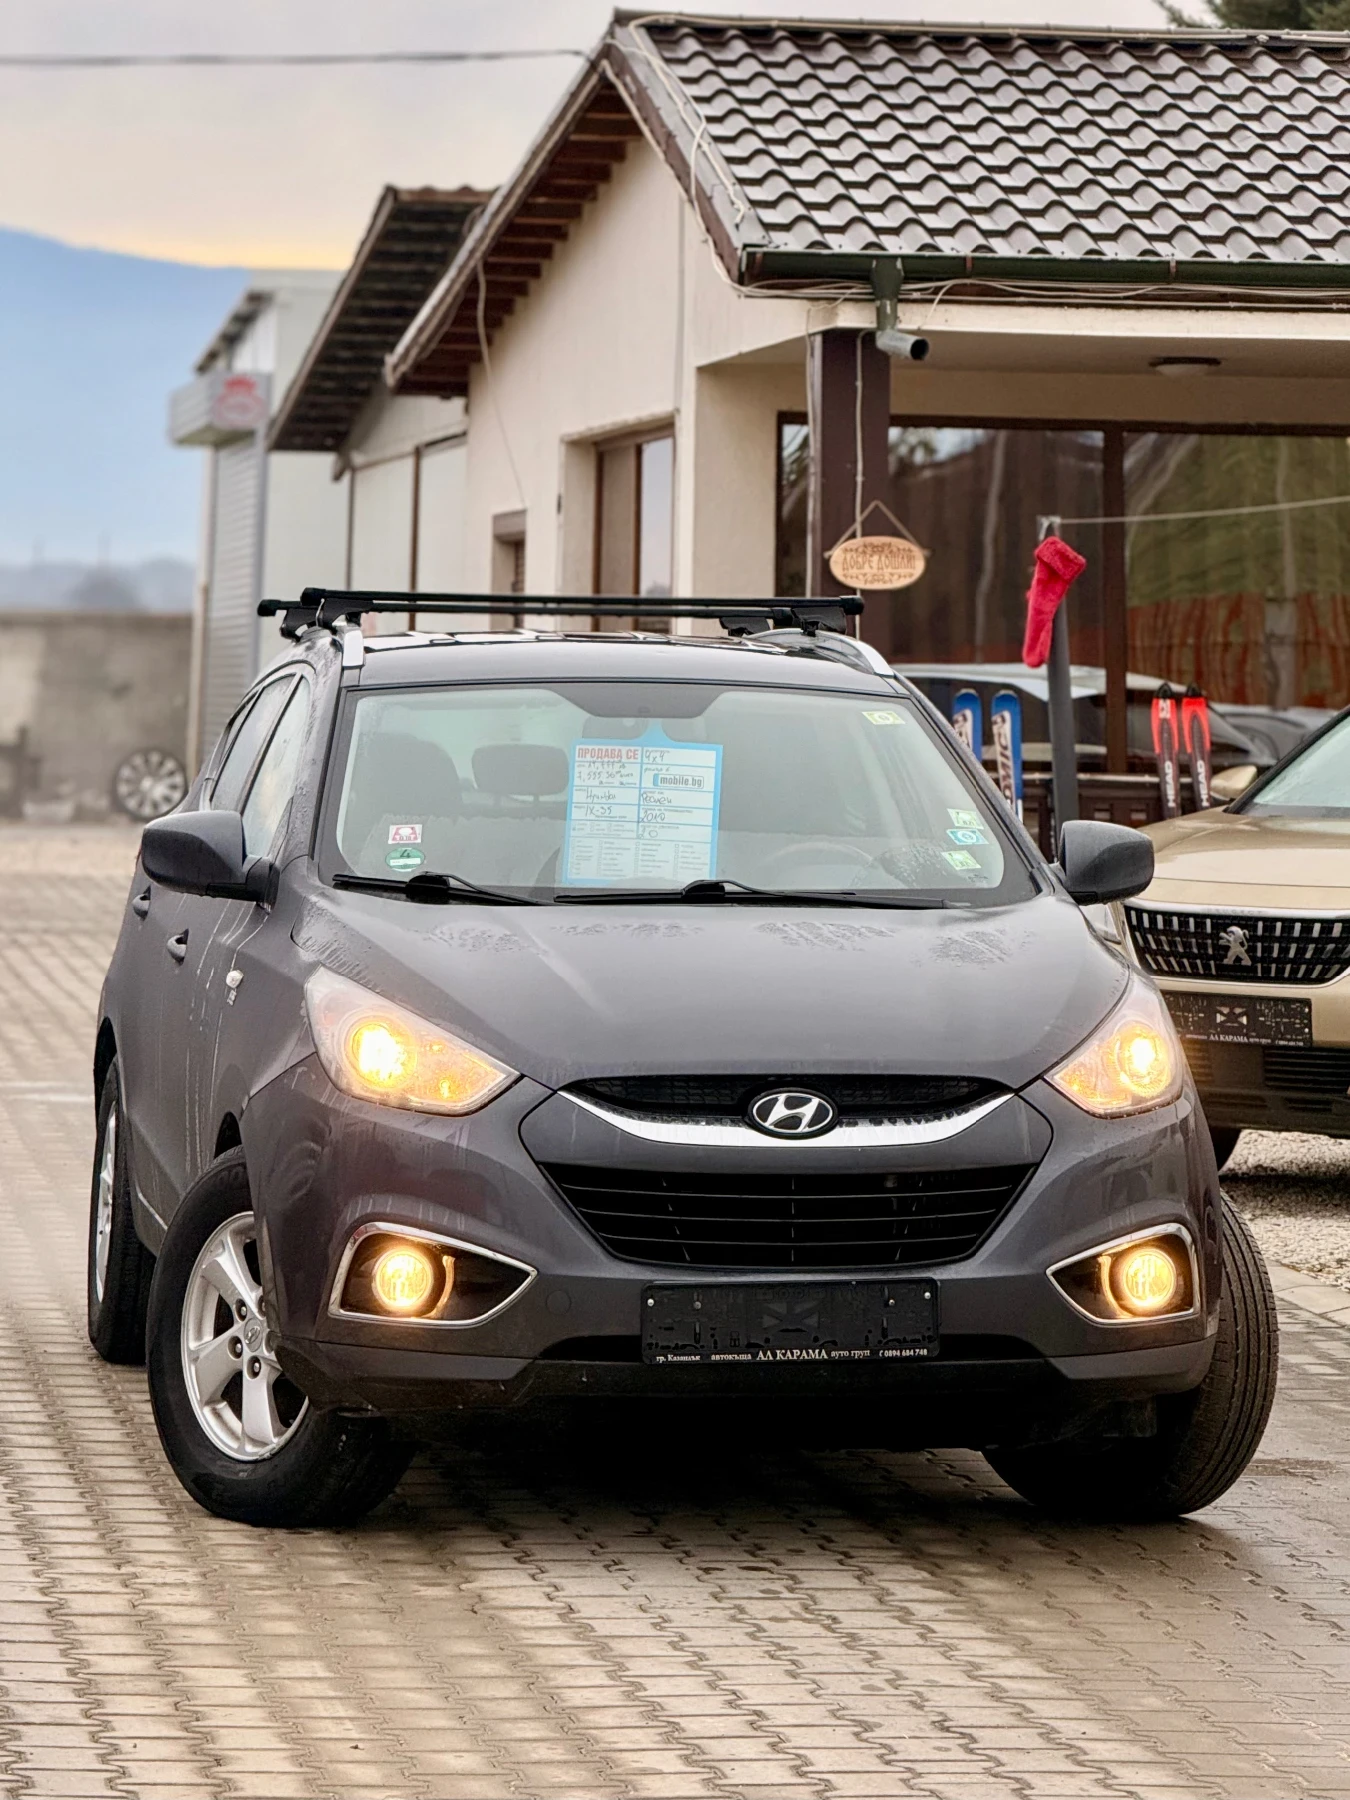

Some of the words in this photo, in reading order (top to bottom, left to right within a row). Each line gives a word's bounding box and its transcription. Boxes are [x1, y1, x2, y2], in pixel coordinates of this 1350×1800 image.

[842, 552, 874, 571] ДОБРЕ
[577, 747, 622, 760] ПРОДАВА
[625, 749, 639, 760] СЕ
[659, 775, 702, 787] mobile.bg
[1164, 760, 1176, 808] HEAD
[1196, 759, 1210, 807] HEAD
[399, 848, 412, 858] 4
[711, 1353, 752, 1361] автокъща
[756, 1349, 774, 1360] АЛ
[775, 1348, 828, 1360] КАРАМА
[830, 1350, 849, 1358] ауто
[850, 1349, 871, 1359] груп
